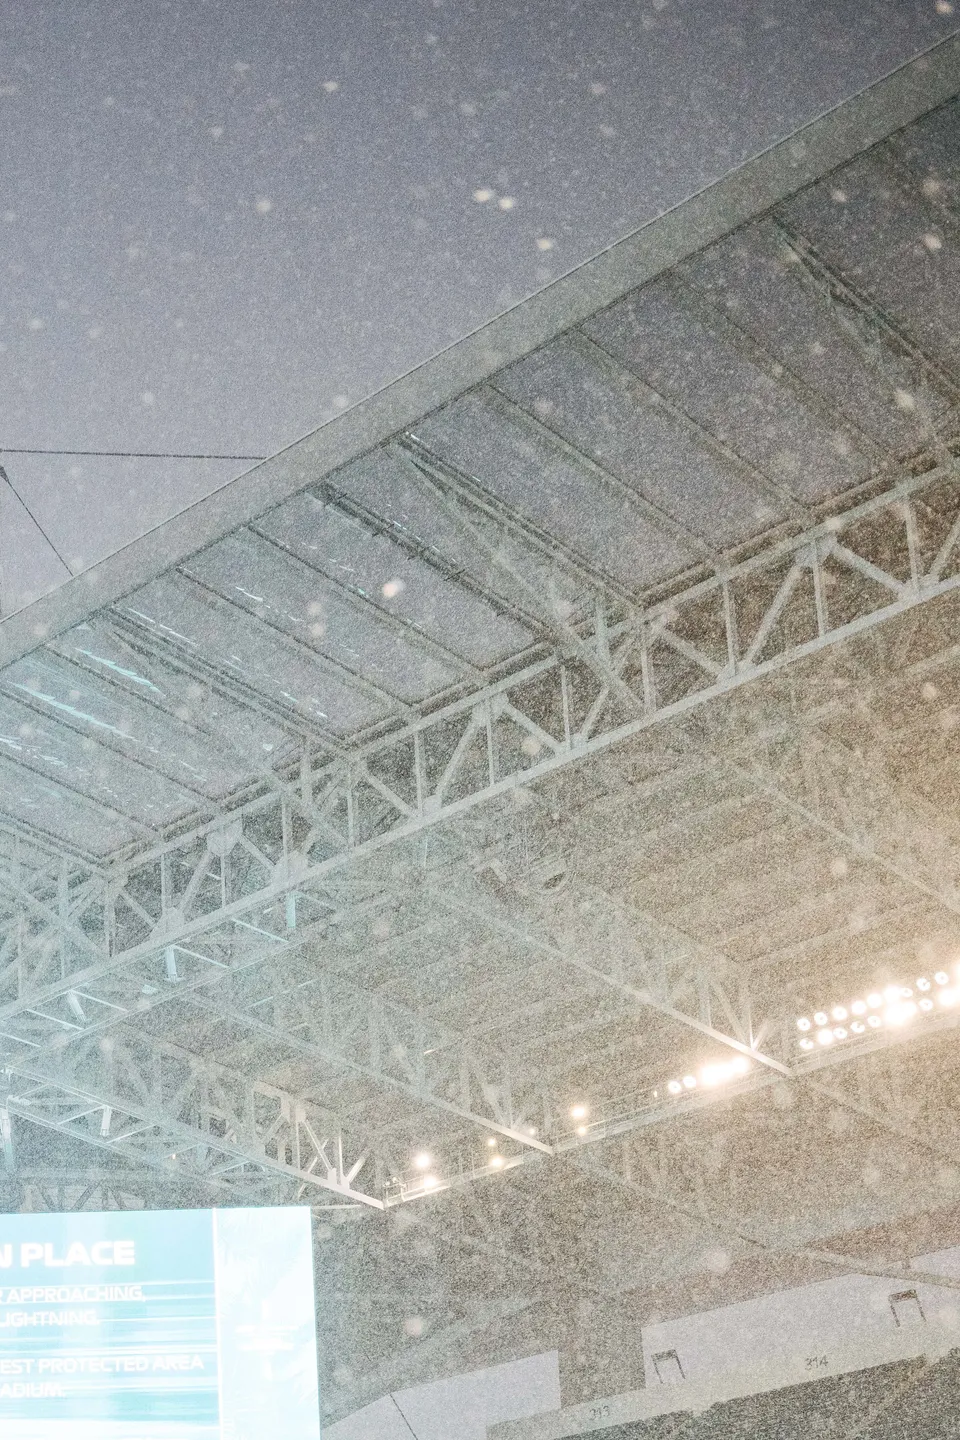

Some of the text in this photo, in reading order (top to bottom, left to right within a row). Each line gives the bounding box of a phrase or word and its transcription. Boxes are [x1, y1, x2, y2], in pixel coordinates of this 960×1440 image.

[20, 1240, 136, 1269] PLACE
[7, 1284, 147, 1304] APPROACHING,
[39, 1354, 150, 1375] PROTECTED
[152, 1353, 204, 1371] AREA
